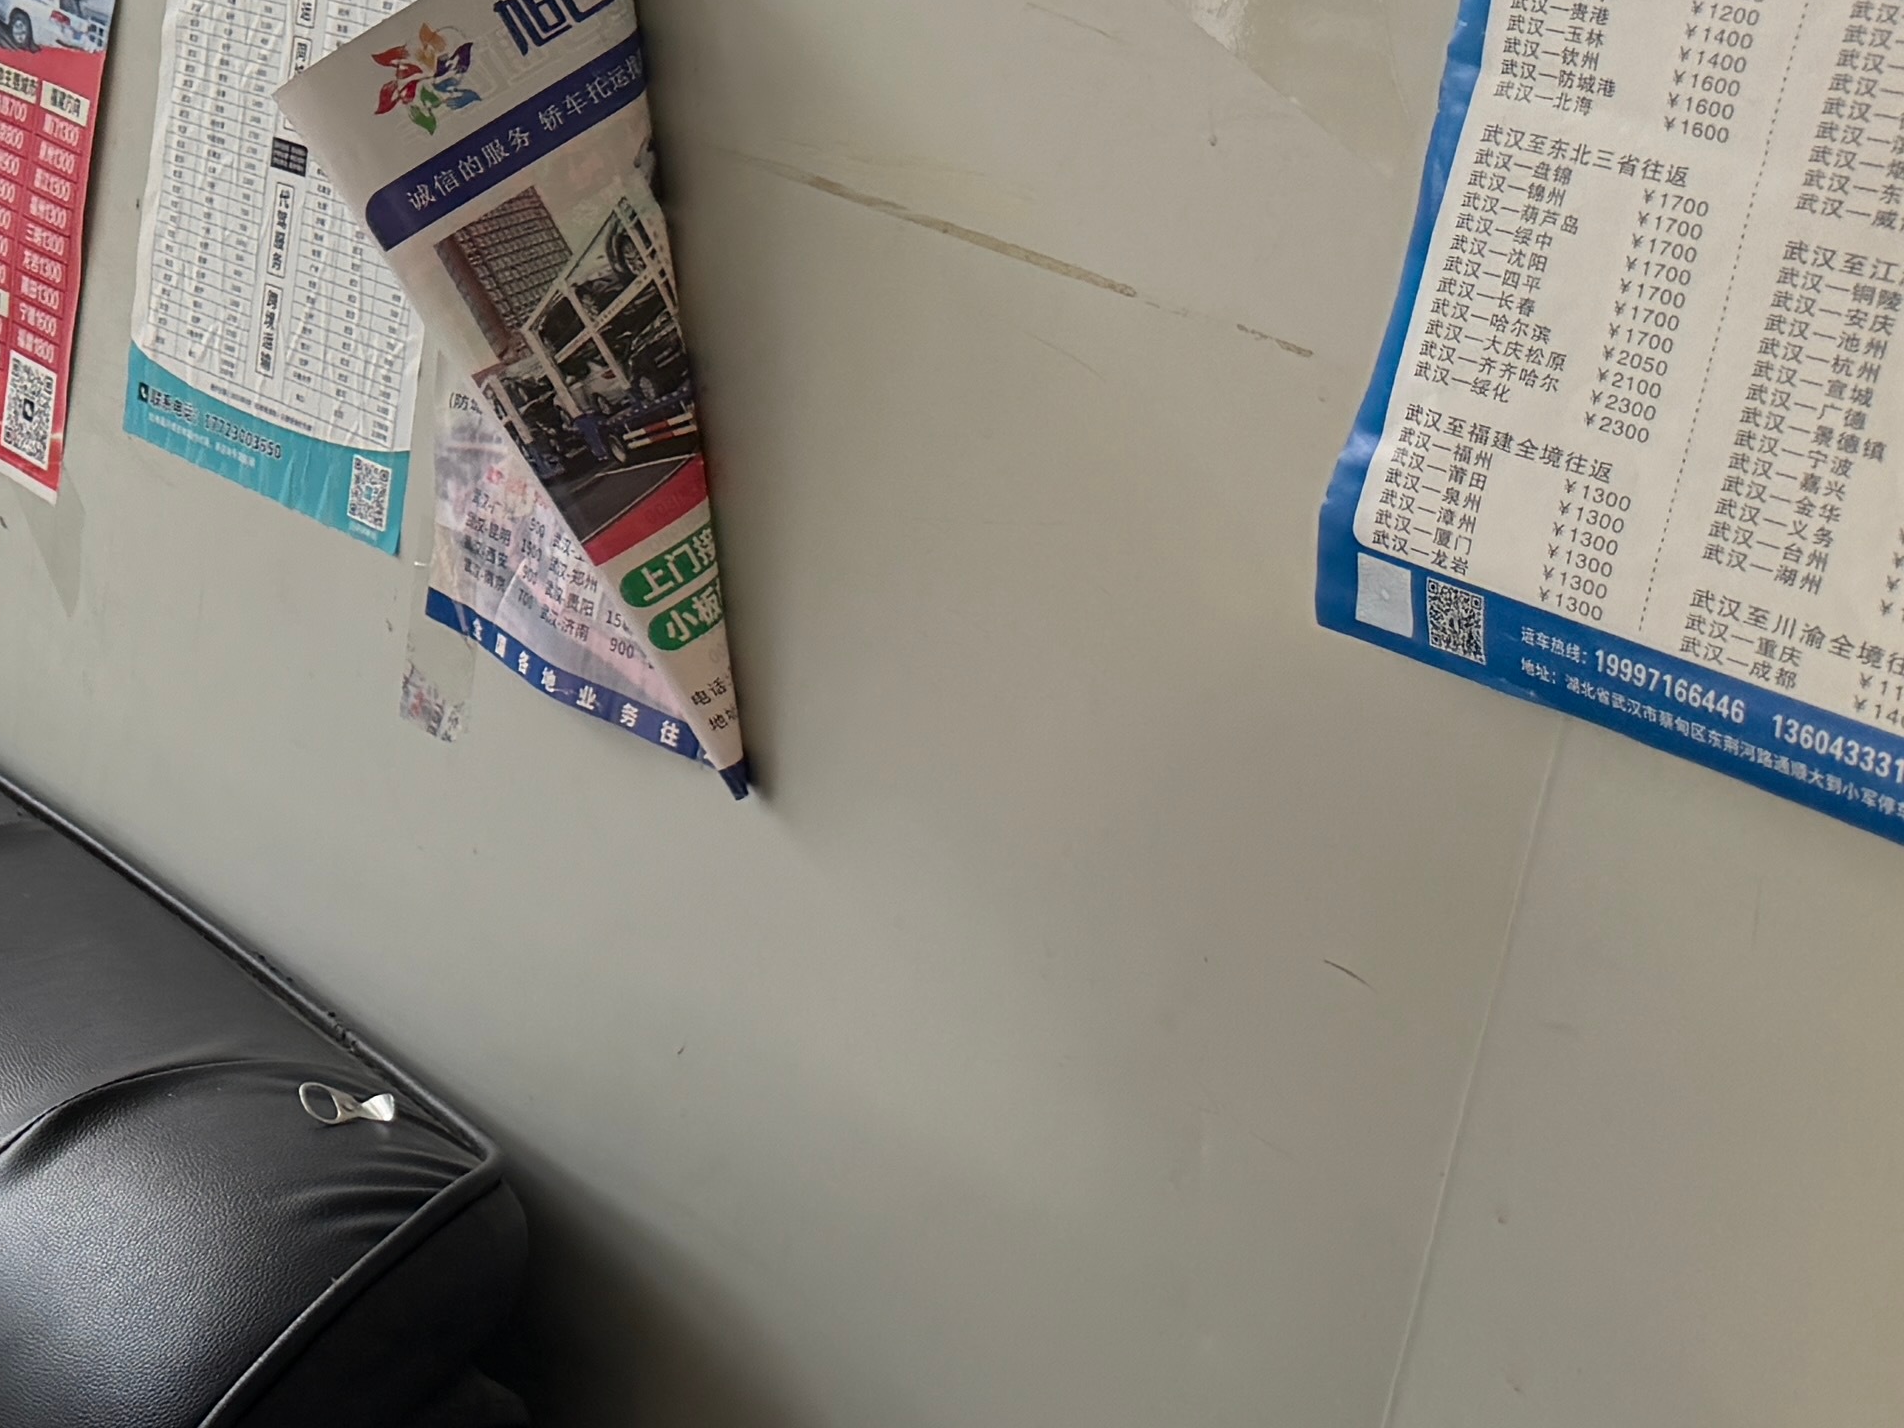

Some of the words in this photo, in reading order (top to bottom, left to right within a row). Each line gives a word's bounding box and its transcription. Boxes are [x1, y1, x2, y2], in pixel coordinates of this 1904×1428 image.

[406, 129, 532, 211] 诚信的服务
[1480, 124, 1691, 188] 武汉至东北三省往返
[1405, 404, 1614, 482] 武汉至福建全境往返
[609, 637, 635, 659] 900
[1594, 649, 1746, 724] 19997166446
